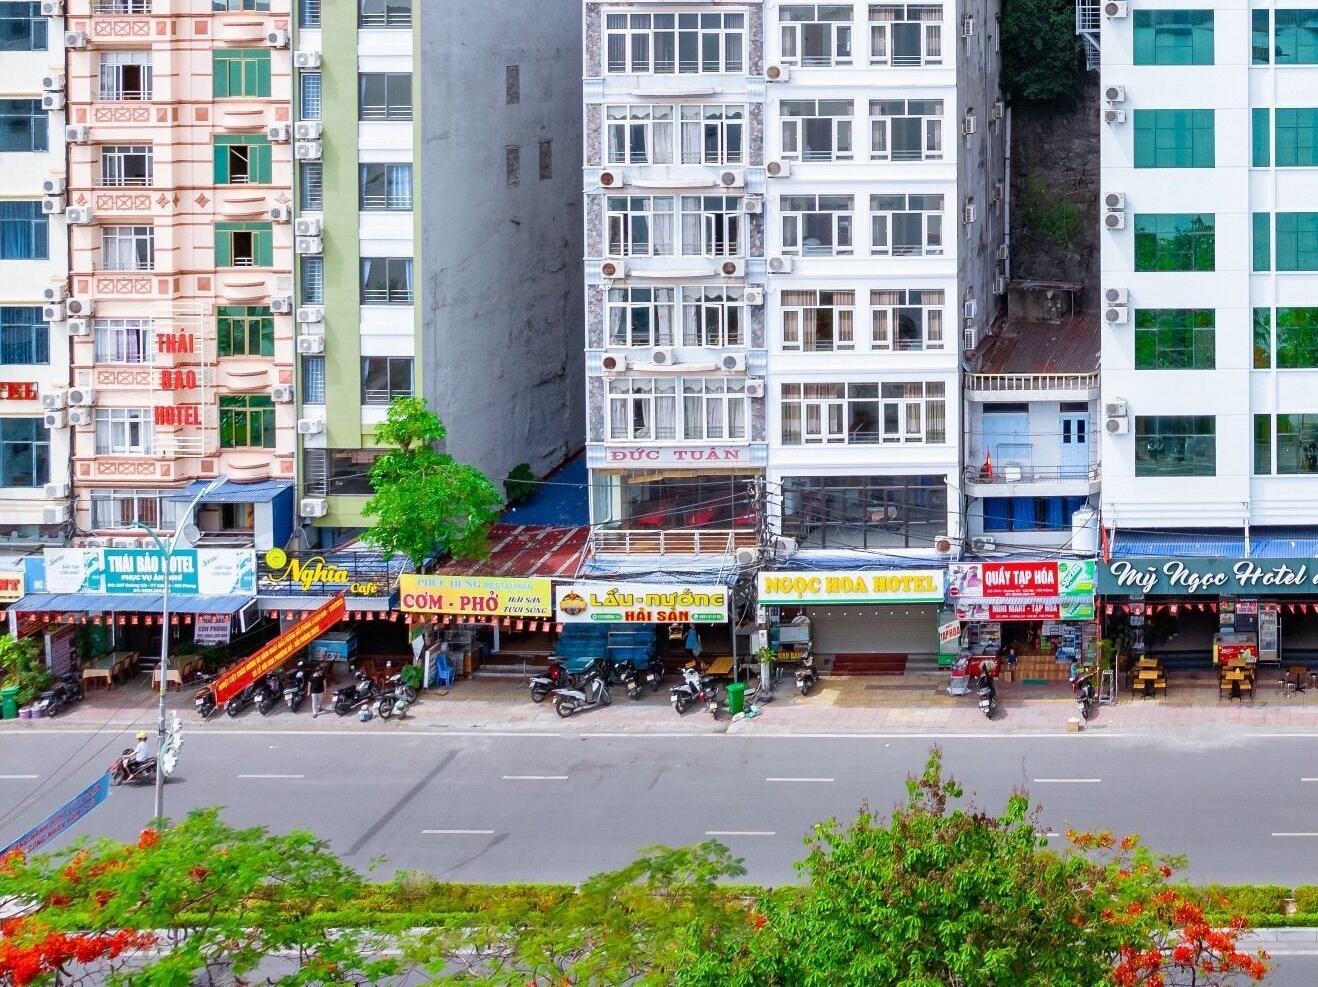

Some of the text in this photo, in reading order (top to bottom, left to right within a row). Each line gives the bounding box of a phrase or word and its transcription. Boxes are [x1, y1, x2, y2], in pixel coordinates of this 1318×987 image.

[156, 328, 194, 353] THÁI
[154, 406, 202, 425] HOTEL
[611, 448, 660, 460] ĐỨC
[108, 554, 134, 572] THÁI
[269, 556, 349, 591] Nghĩa
[1013, 571, 1032, 588] TẠP
[1110, 560, 1158, 592] Mỹ
[1163, 560, 1228, 590] Ngọc
[1233, 561, 1306, 586] Hotel
[350, 581, 379, 595] Café
[764, 575, 937, 598] NGỌC HOA HOTEL
[460, 590, 499, 612] PHỞ
